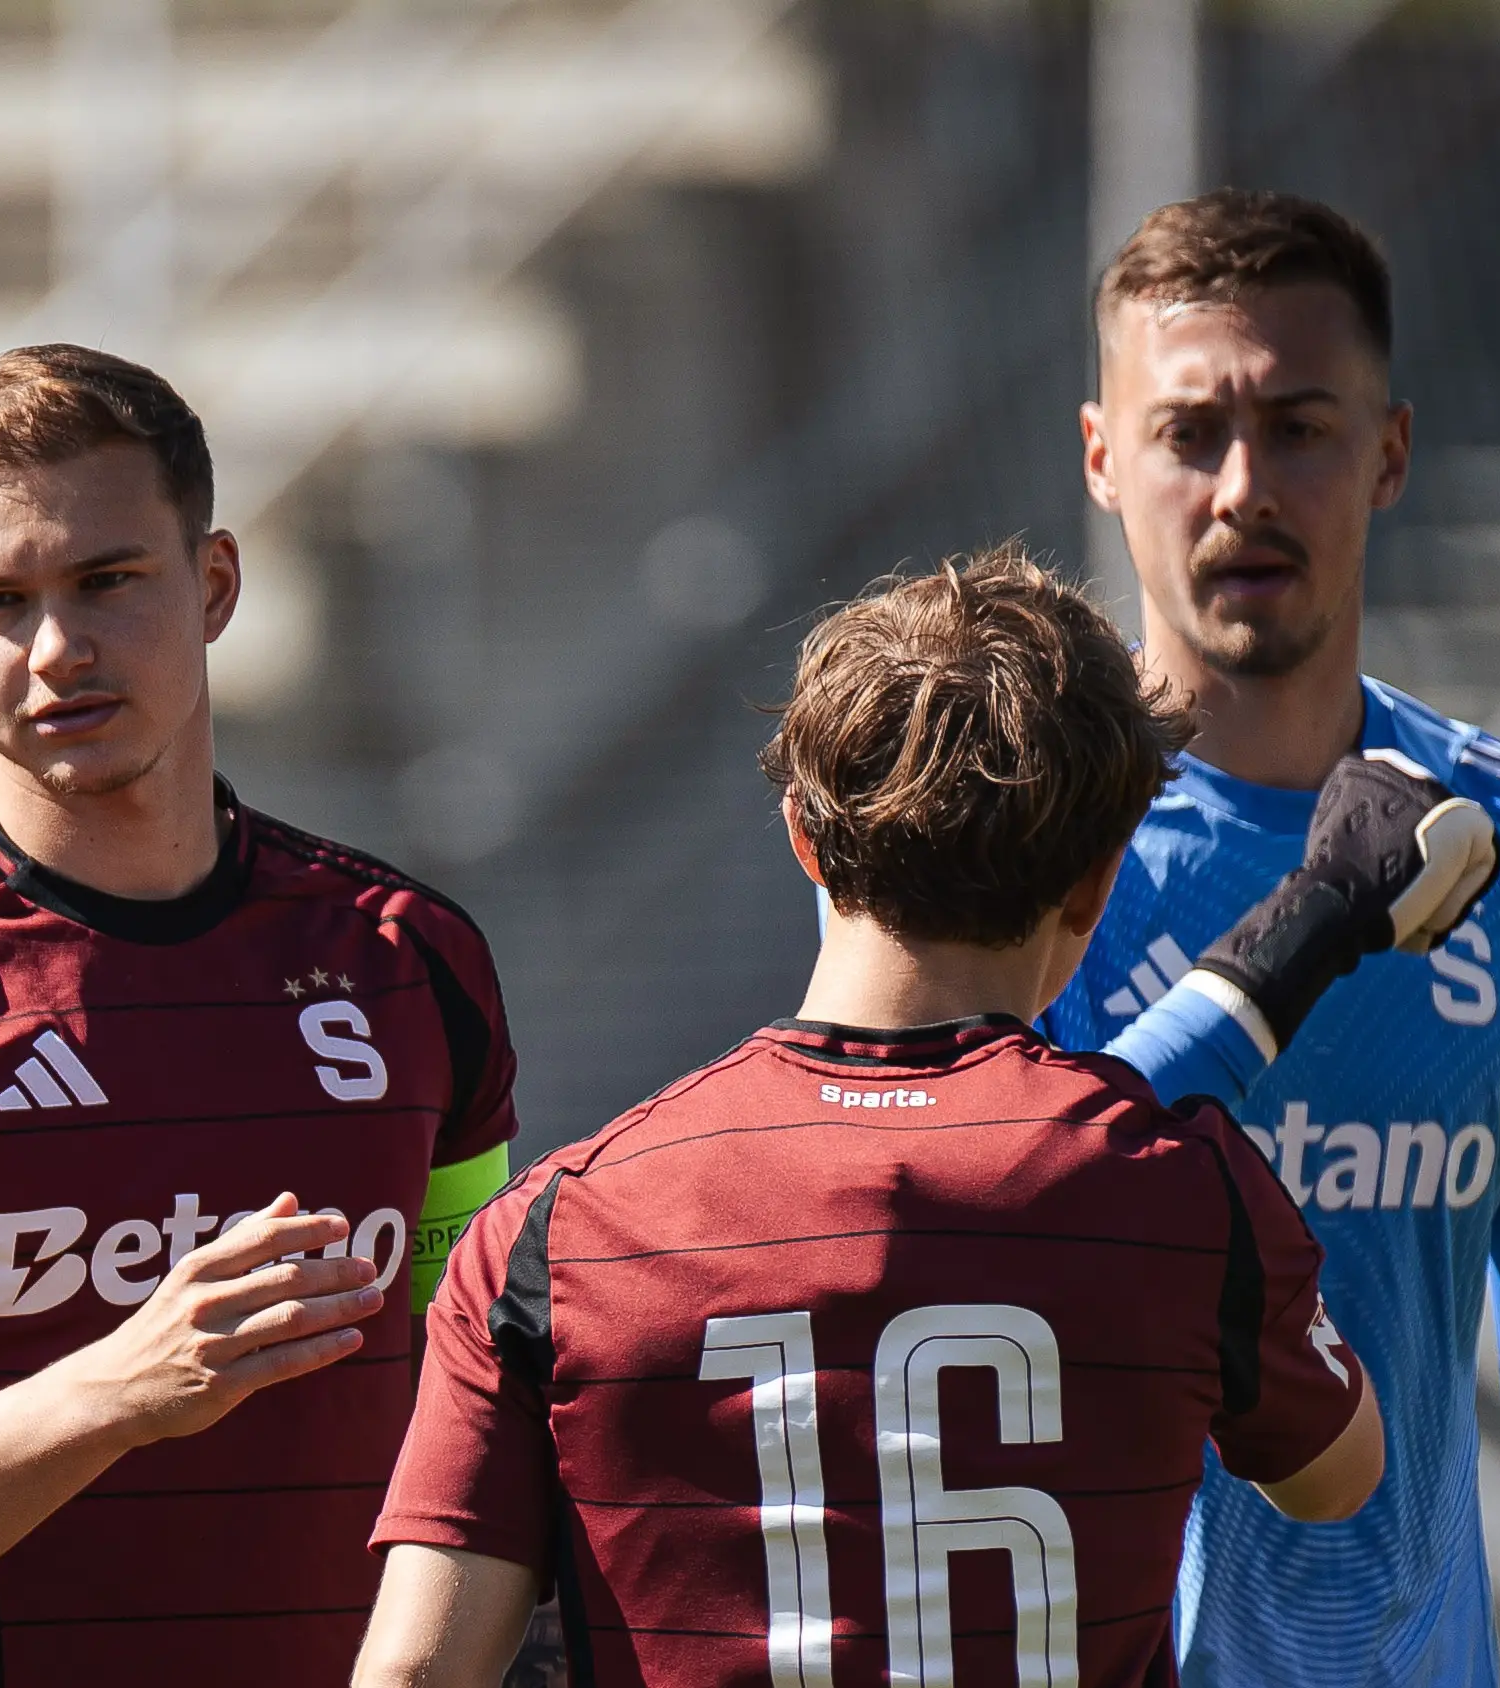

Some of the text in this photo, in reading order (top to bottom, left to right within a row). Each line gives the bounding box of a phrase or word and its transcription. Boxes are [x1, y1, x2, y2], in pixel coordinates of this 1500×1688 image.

[1430, 919, 1497, 1027] S
[298, 1000, 388, 1101] S
[820, 1083, 937, 1109] Sparta.
